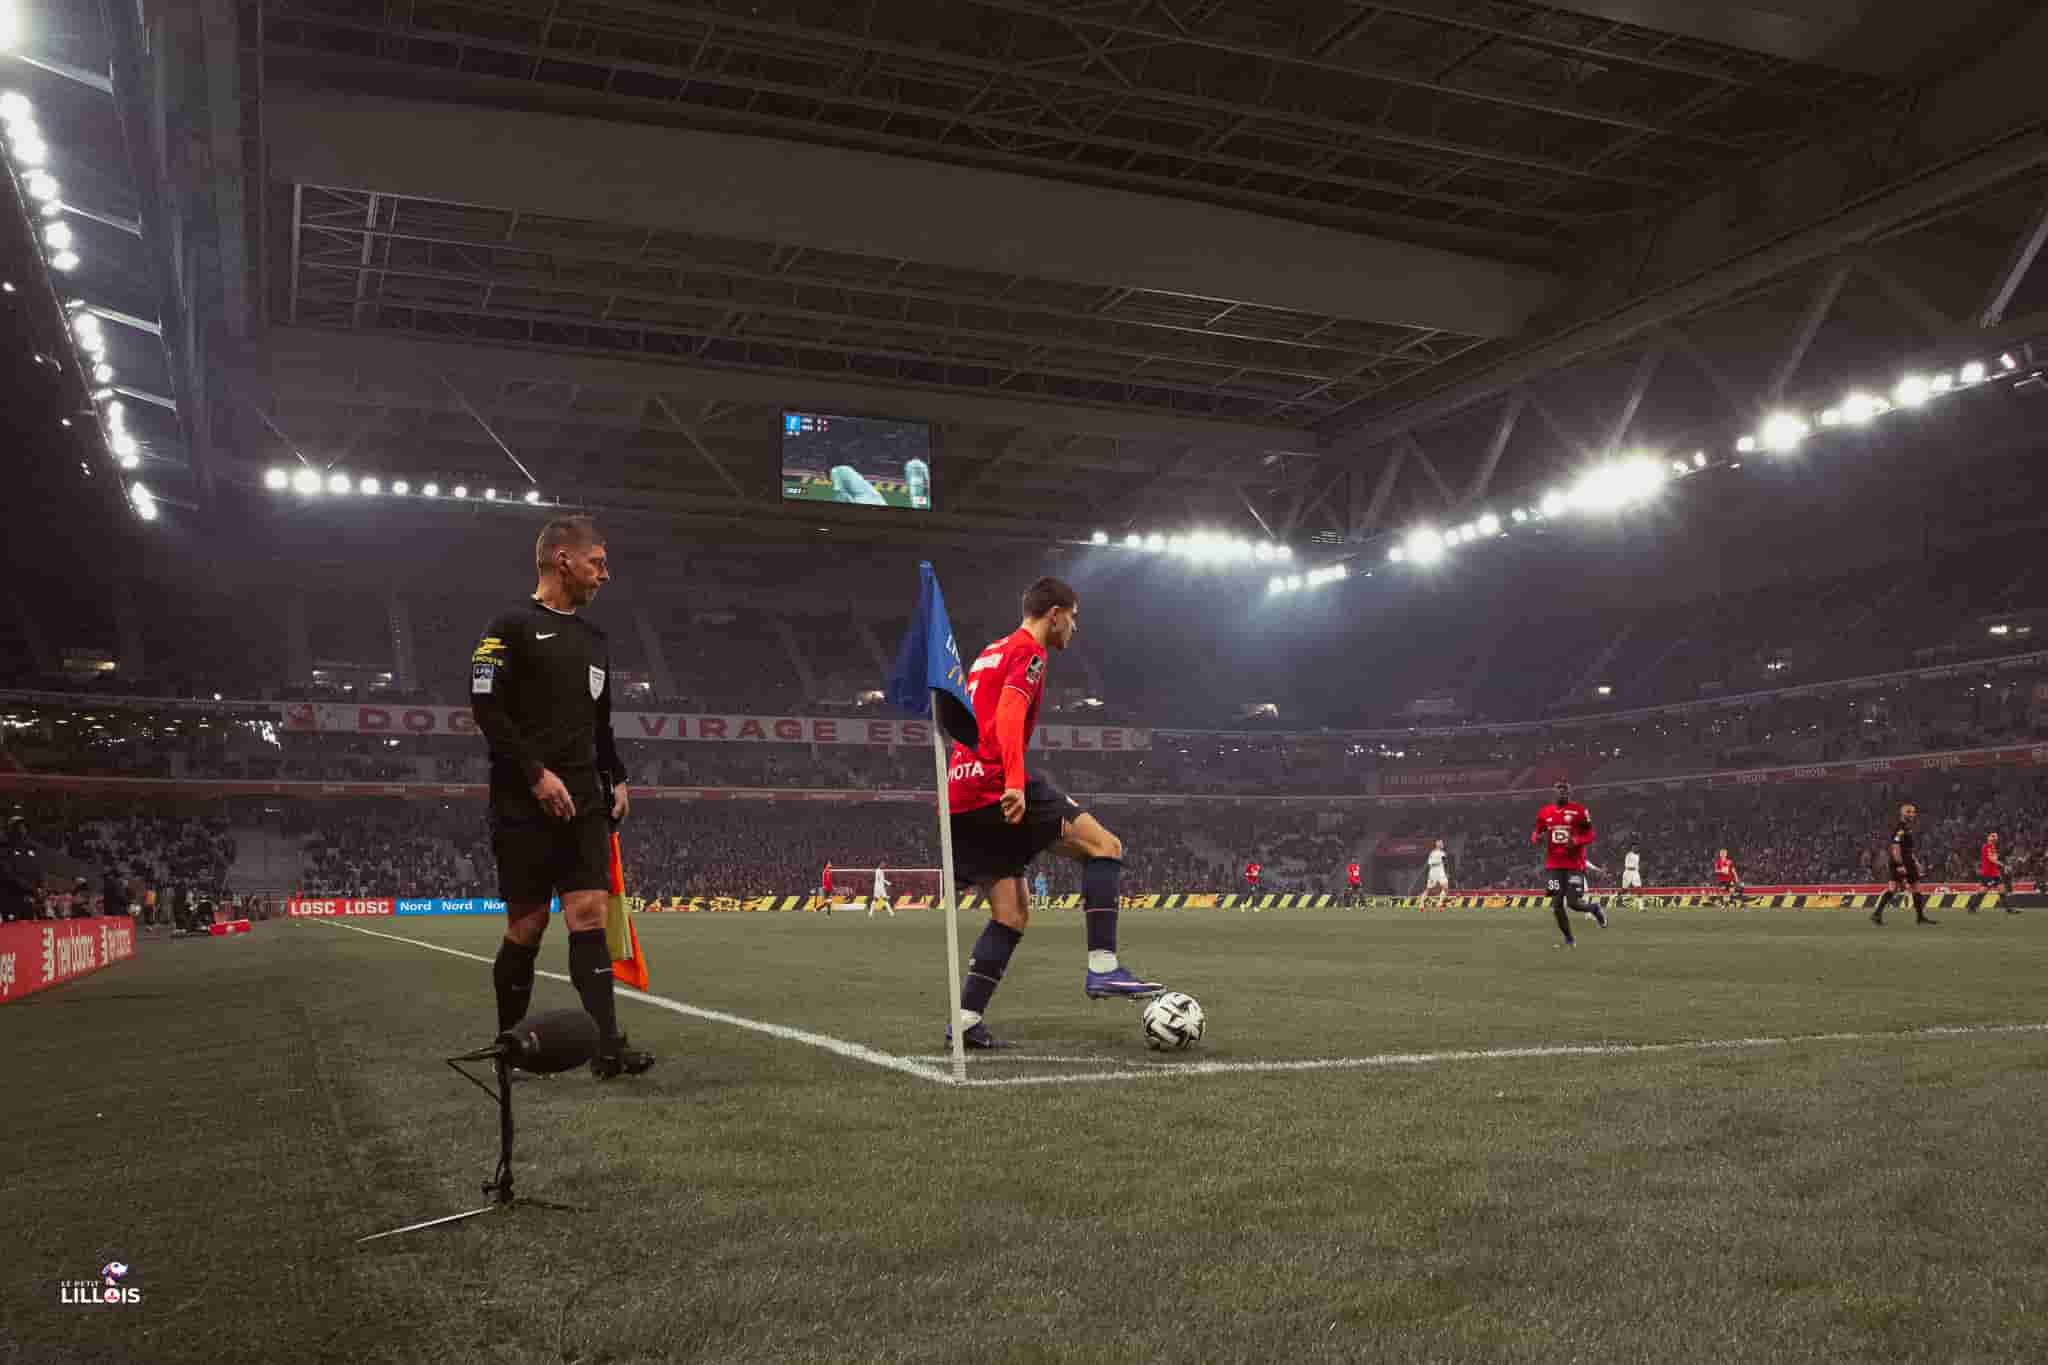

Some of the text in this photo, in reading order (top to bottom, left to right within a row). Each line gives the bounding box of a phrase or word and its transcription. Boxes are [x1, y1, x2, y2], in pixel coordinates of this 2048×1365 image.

[638, 715, 836, 742] VIRAGE
[290, 901, 336, 915] LOSC
[345, 900, 389, 914] LOSC
[400, 901, 432, 911] Nord
[442, 901, 473, 911] Nord
[483, 901, 505, 911] Nor
